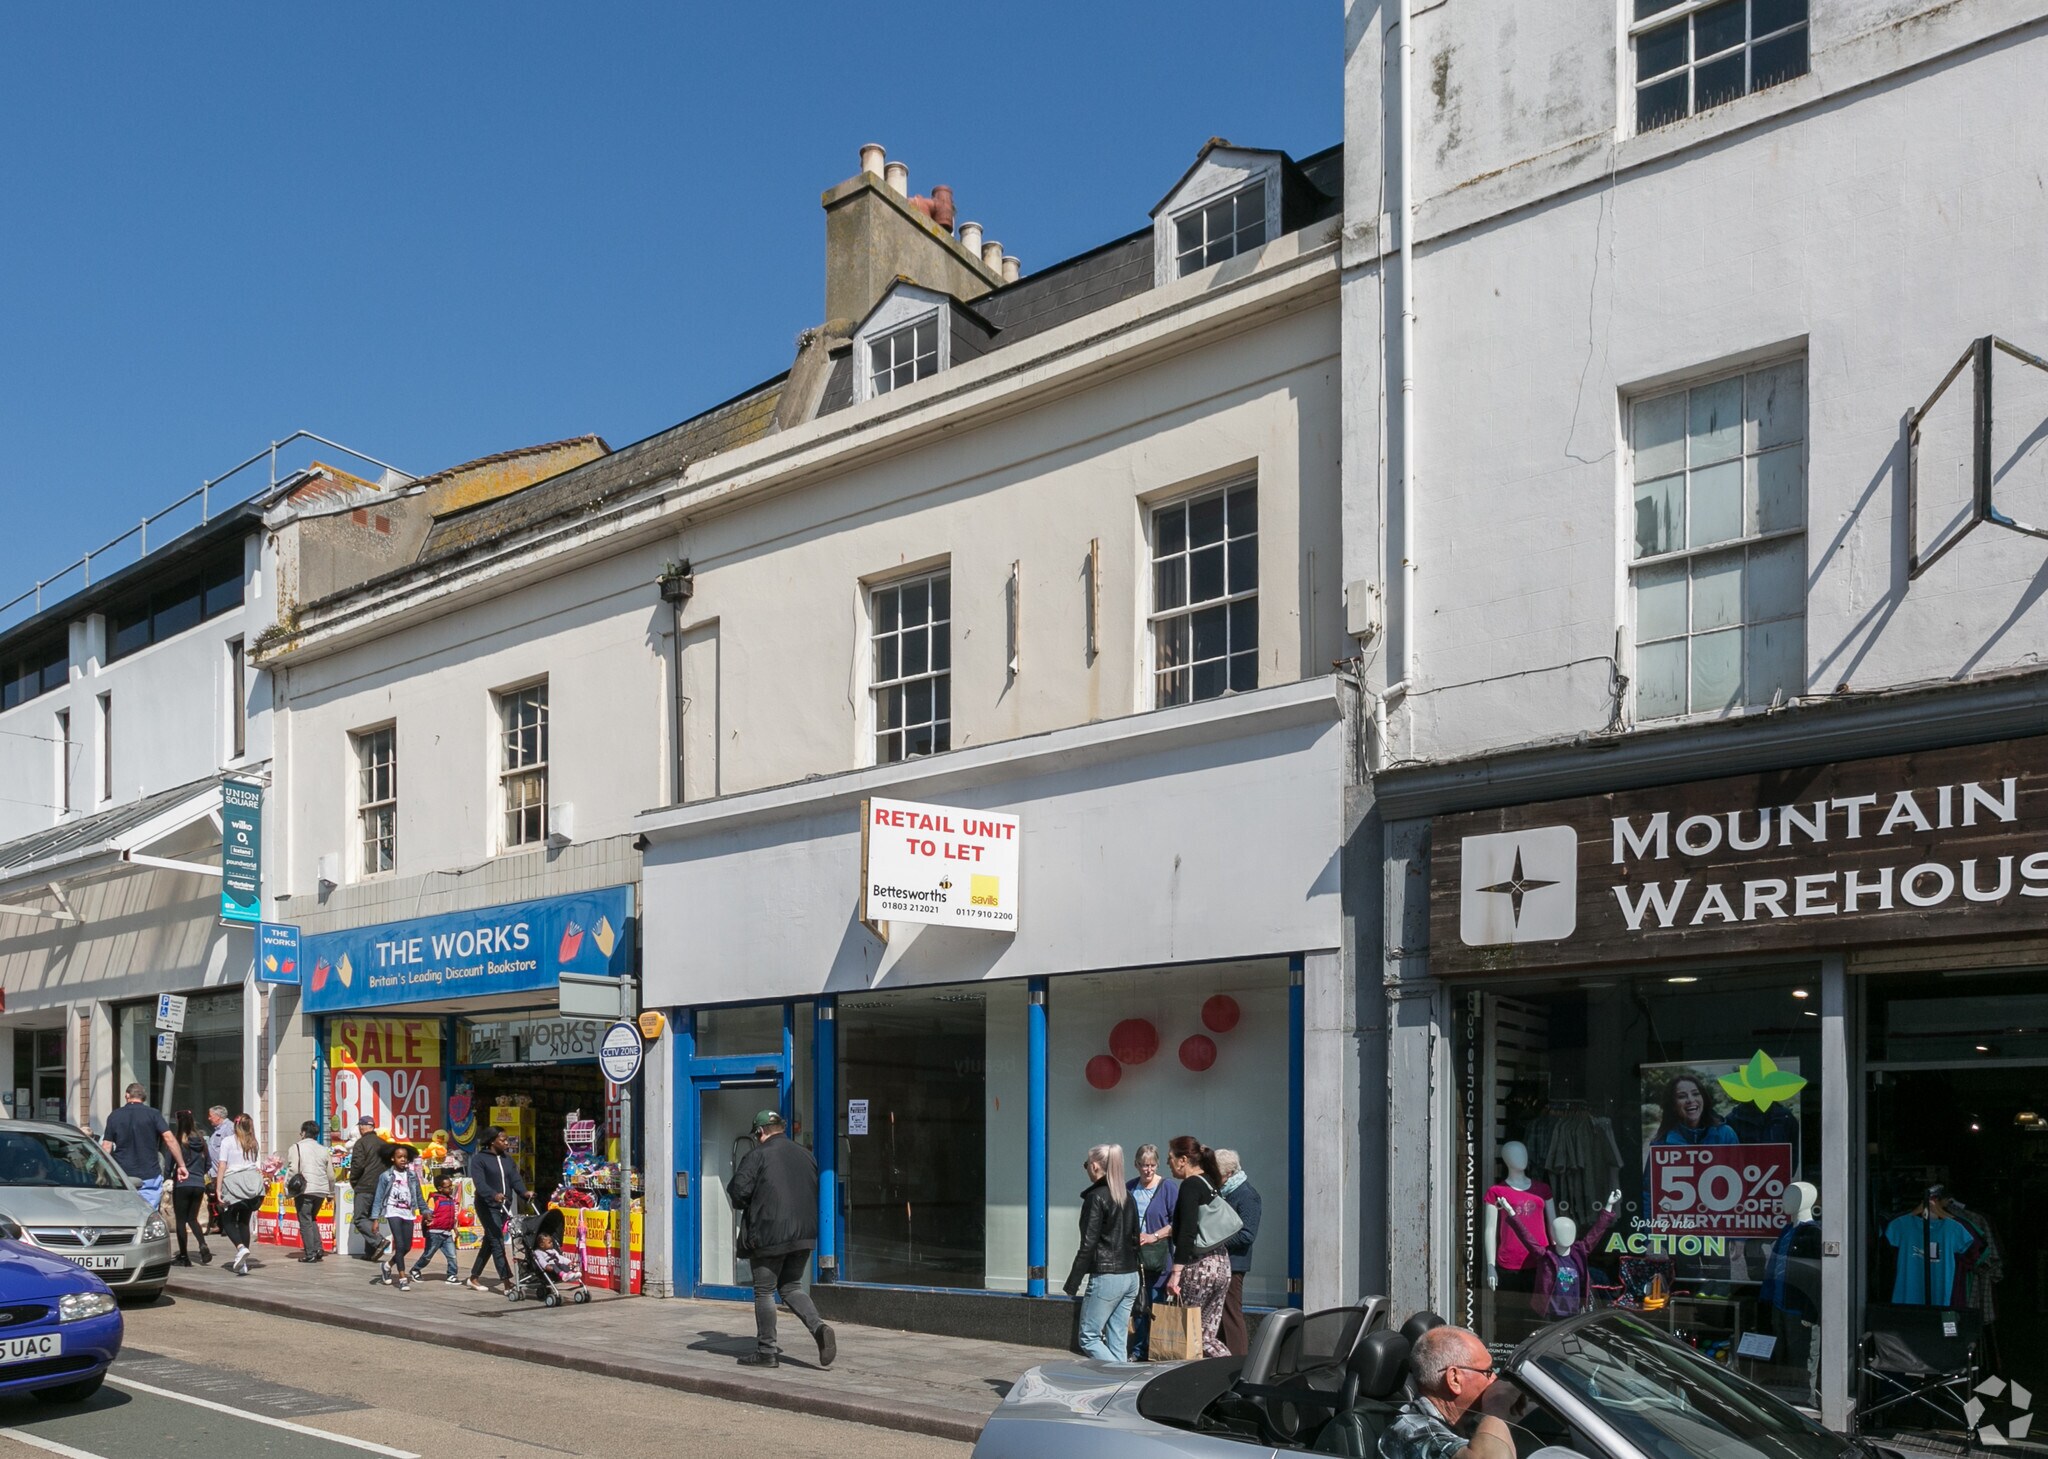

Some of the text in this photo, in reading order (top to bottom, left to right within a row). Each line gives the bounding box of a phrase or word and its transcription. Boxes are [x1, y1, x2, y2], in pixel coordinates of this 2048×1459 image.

[225, 787, 259, 801] UNION
[225, 796, 259, 809] SQUARE
[231, 820, 253, 831] wilko
[875, 808, 1015, 840] RETAIL UNIT
[1611, 777, 2018, 865] MOUNTAIN
[907, 838, 985, 862] TO LET
[873, 884, 947, 903] Bettesworths
[1611, 851, 2048, 931] WAREHOUS
[882, 901, 939, 914] 01803 212021
[971, 894, 998, 907] savills
[956, 908, 1013, 920] 0117 910 2200
[271, 929, 289, 938] THE
[264, 937, 297, 948] WORKS
[375, 922, 530, 967] THE WORKS
[369, 959, 537, 988] Britain's Leading Discount Bookstore
[162, 995, 169, 1006] P
[518, 1020, 597, 1048] WORKS
[341, 1022, 423, 1065] SALE
[602, 1046, 639, 1057] CCTV ZONE
[335, 1069, 429, 1141] 80%
[1655, 1150, 1713, 1165] UP TO
[1658, 1164, 1784, 1212] 50%
[586, 1217, 605, 1228] STOCK
[1630, 1215, 1697, 1233] Spring into
[1656, 1213, 1787, 1230] EVERYTHING
[1605, 1232, 1725, 1257] ACTION
[97, 1256, 119, 1268] LWY
[11, 1337, 51, 1357] UAC
